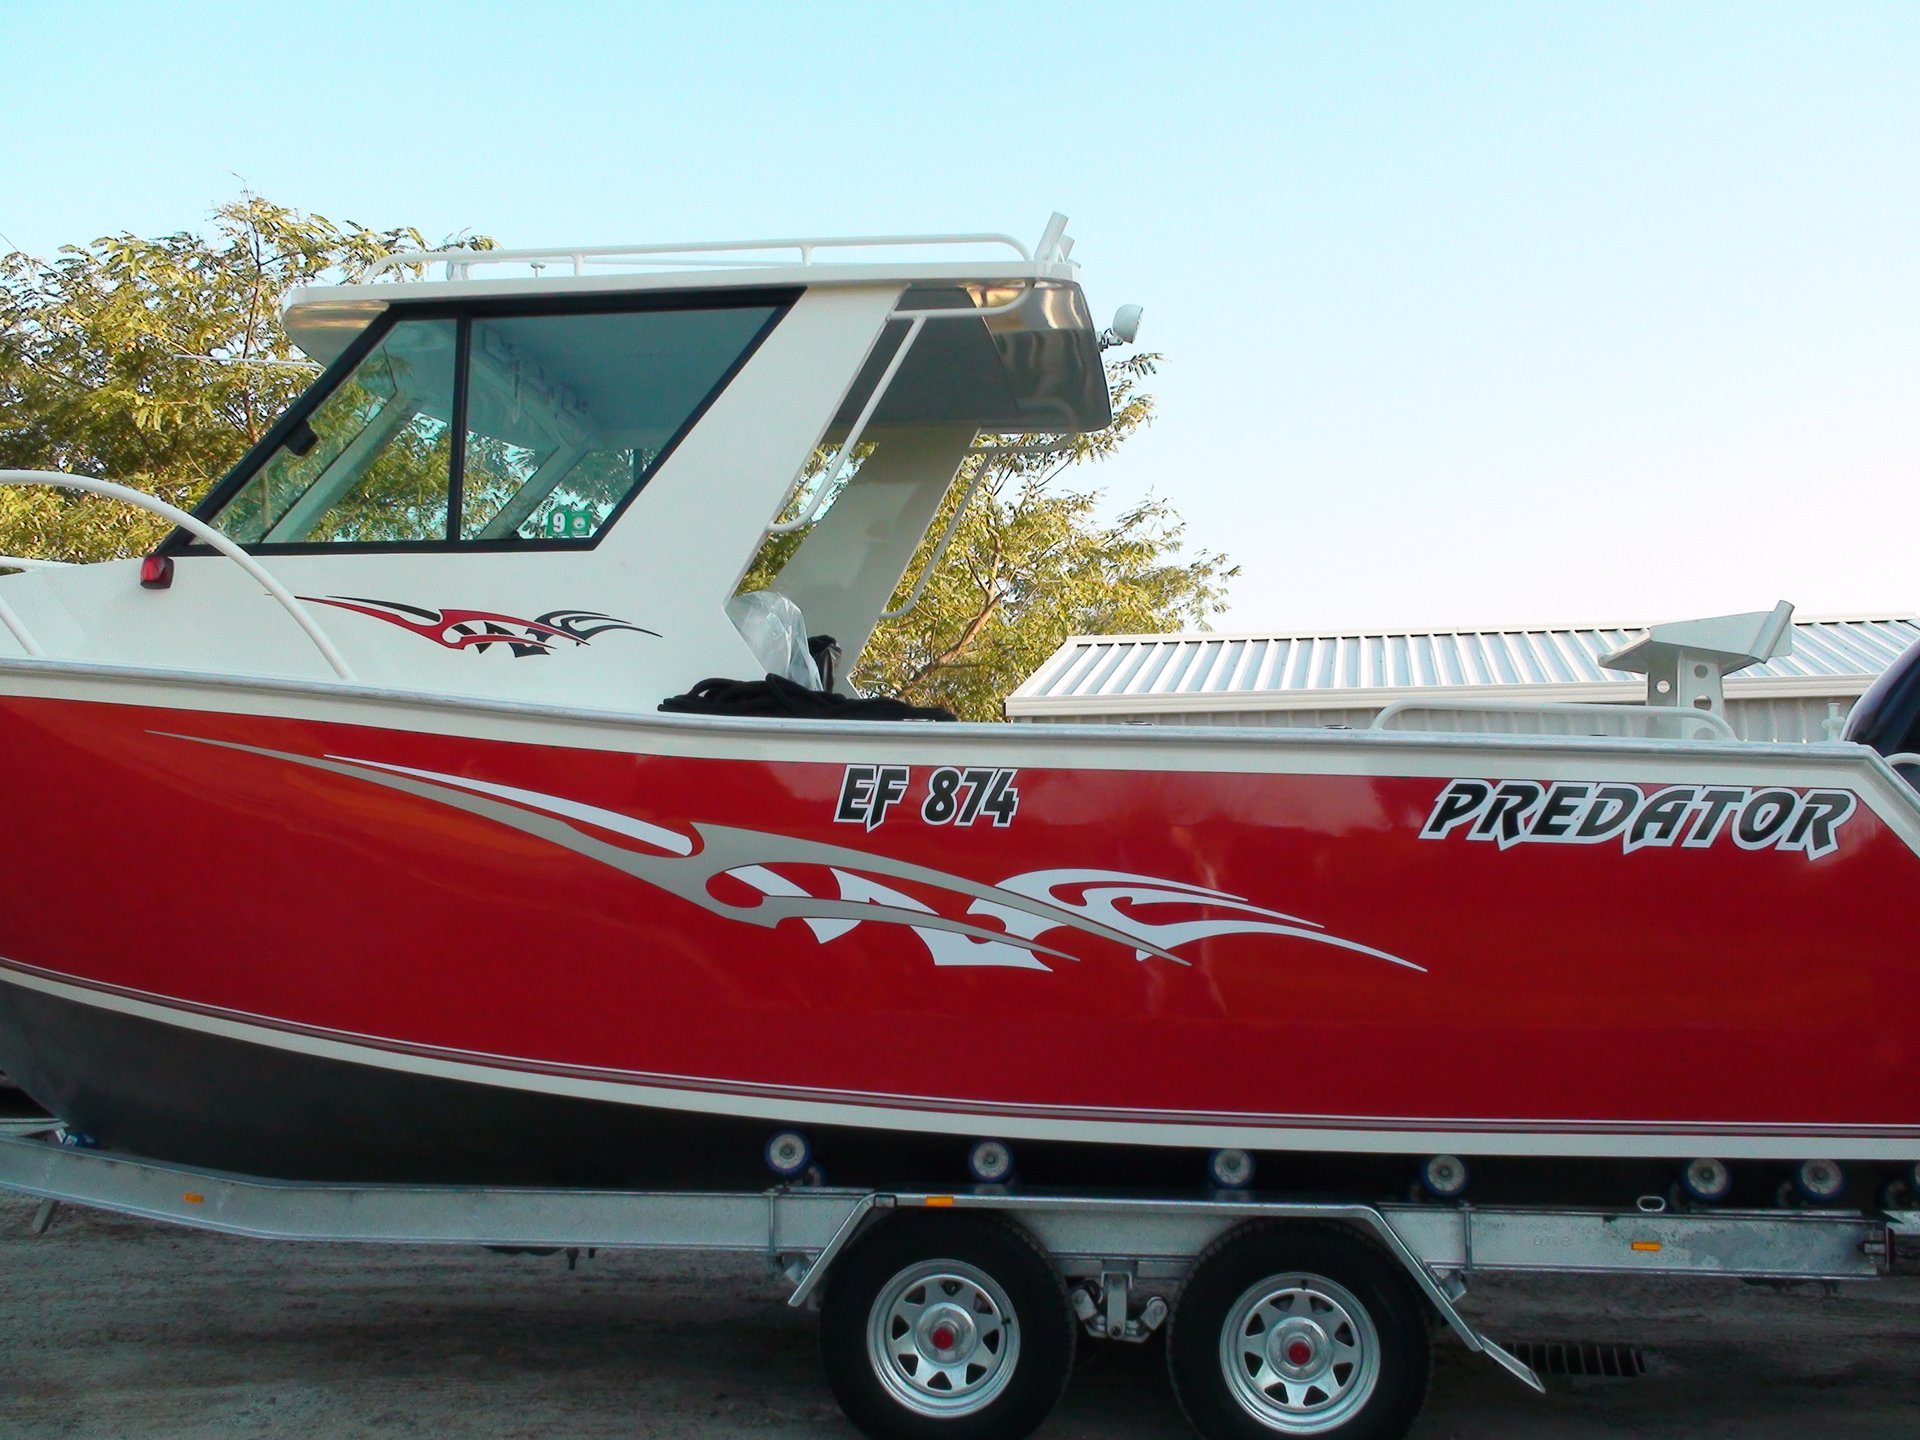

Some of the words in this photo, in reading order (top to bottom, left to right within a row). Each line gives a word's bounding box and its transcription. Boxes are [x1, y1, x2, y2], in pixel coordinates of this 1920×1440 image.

[553, 512, 566, 533] 9
[834, 764, 910, 833] EF
[921, 766, 1019, 828] 874
[1418, 778, 1857, 862] PREDATOR
